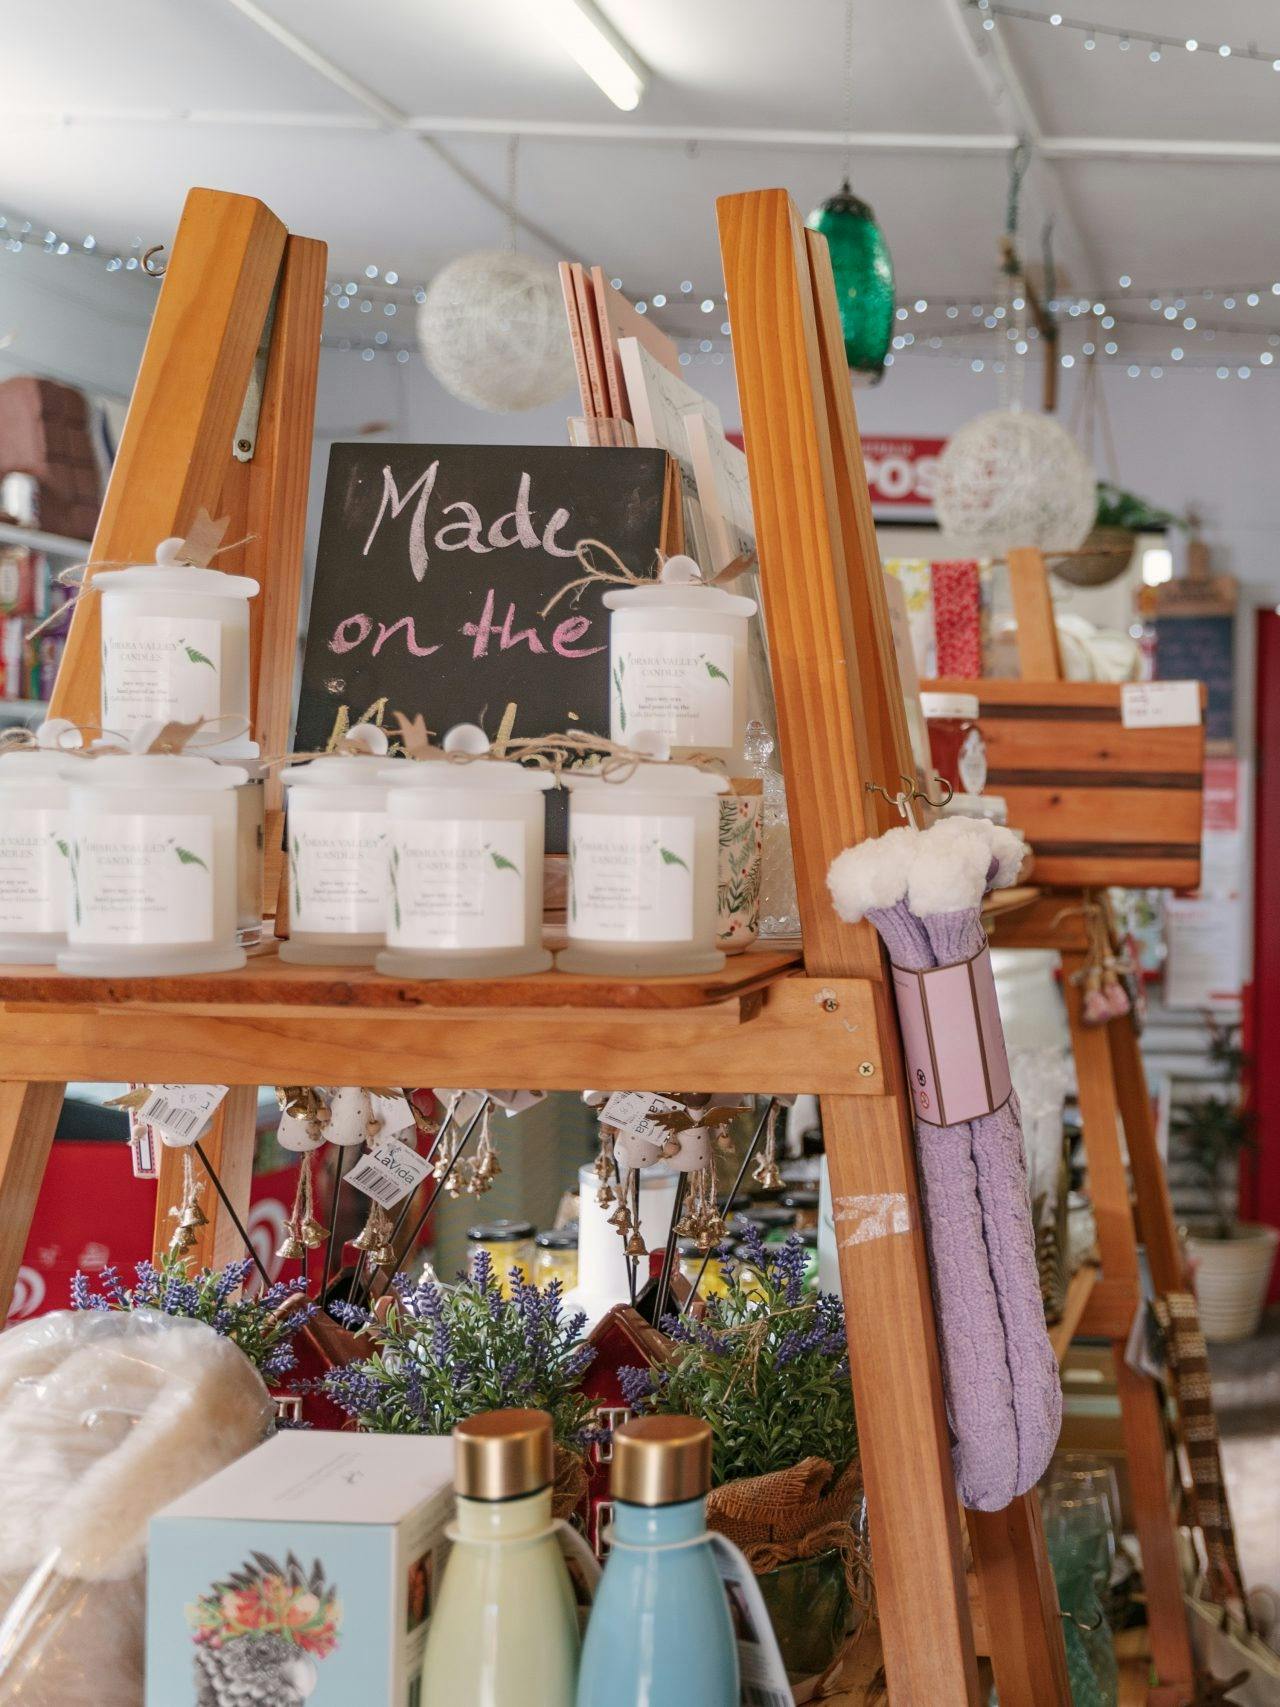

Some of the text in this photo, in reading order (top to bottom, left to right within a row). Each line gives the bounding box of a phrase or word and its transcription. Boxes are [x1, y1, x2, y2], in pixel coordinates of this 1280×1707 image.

[363, 460, 580, 583] Made
[329, 588, 608, 661] on the
[642, 669, 686, 677] CANDLES
[661, 656, 699, 666] VALLEY
